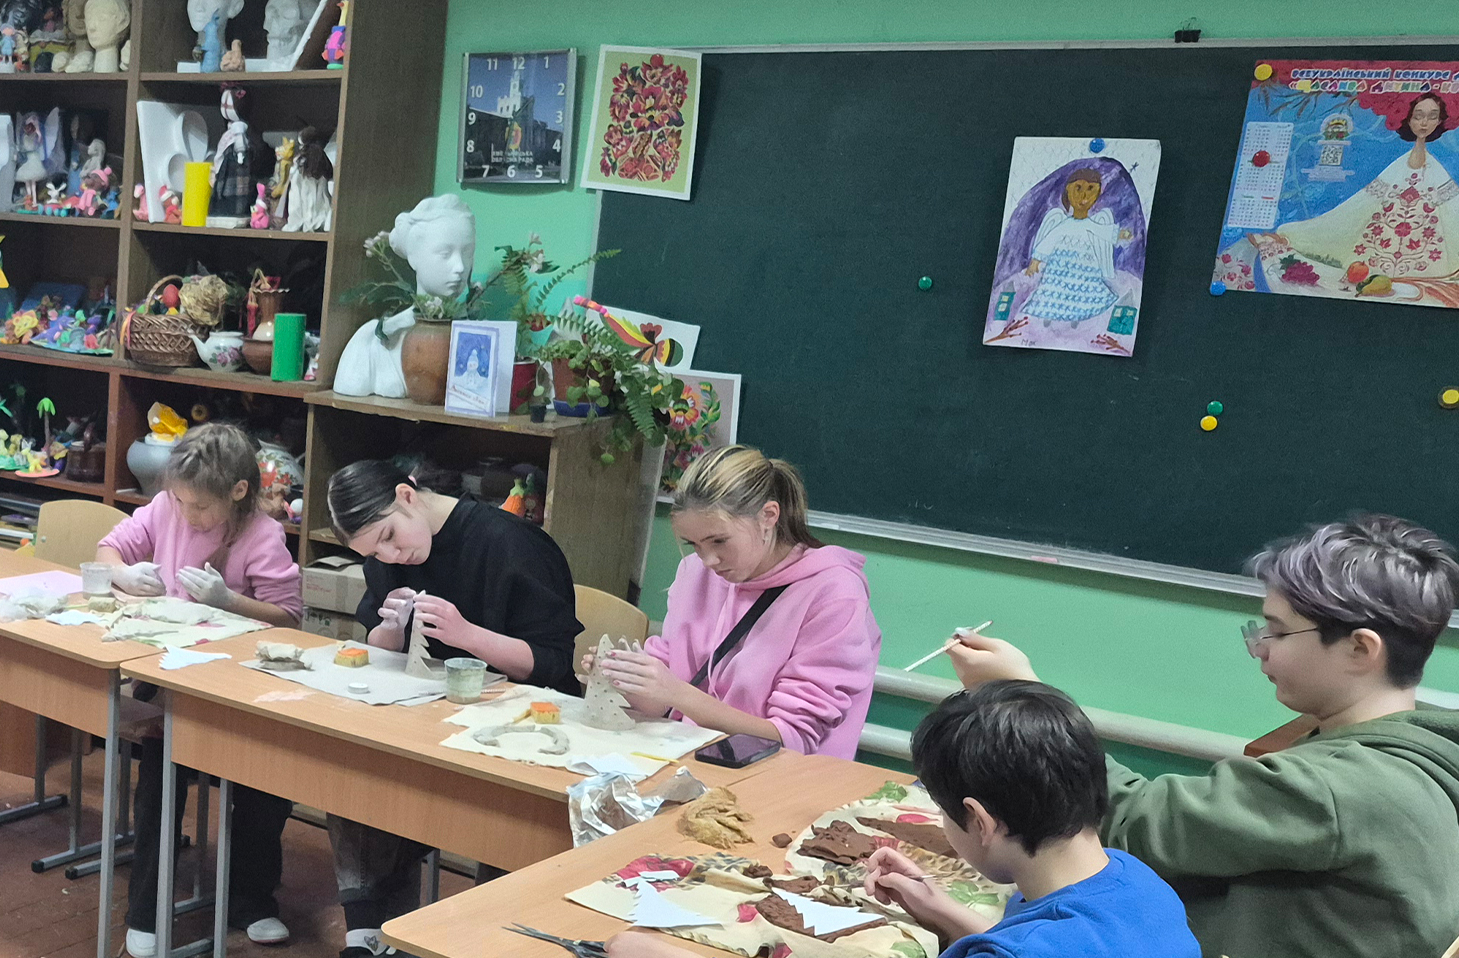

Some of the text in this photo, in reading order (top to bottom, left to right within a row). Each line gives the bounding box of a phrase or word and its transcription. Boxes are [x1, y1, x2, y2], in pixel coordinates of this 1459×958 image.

[487, 56, 549, 71] 11 12 1
[1291, 67, 1391, 79] ВСЕУКРАЇНСЬКИЙ
[1394, 70, 1451, 80] КОНКУРС
[470, 85, 483, 98] 10
[557, 83, 565, 95] 2
[1370, 80, 1431, 94] ДИТИНА
[468, 112, 476, 125] 9
[555, 111, 563, 123] 3
[466, 140, 474, 153] 8
[552, 139, 561, 152] 4
[482, 165, 543, 178] 7 6 5
